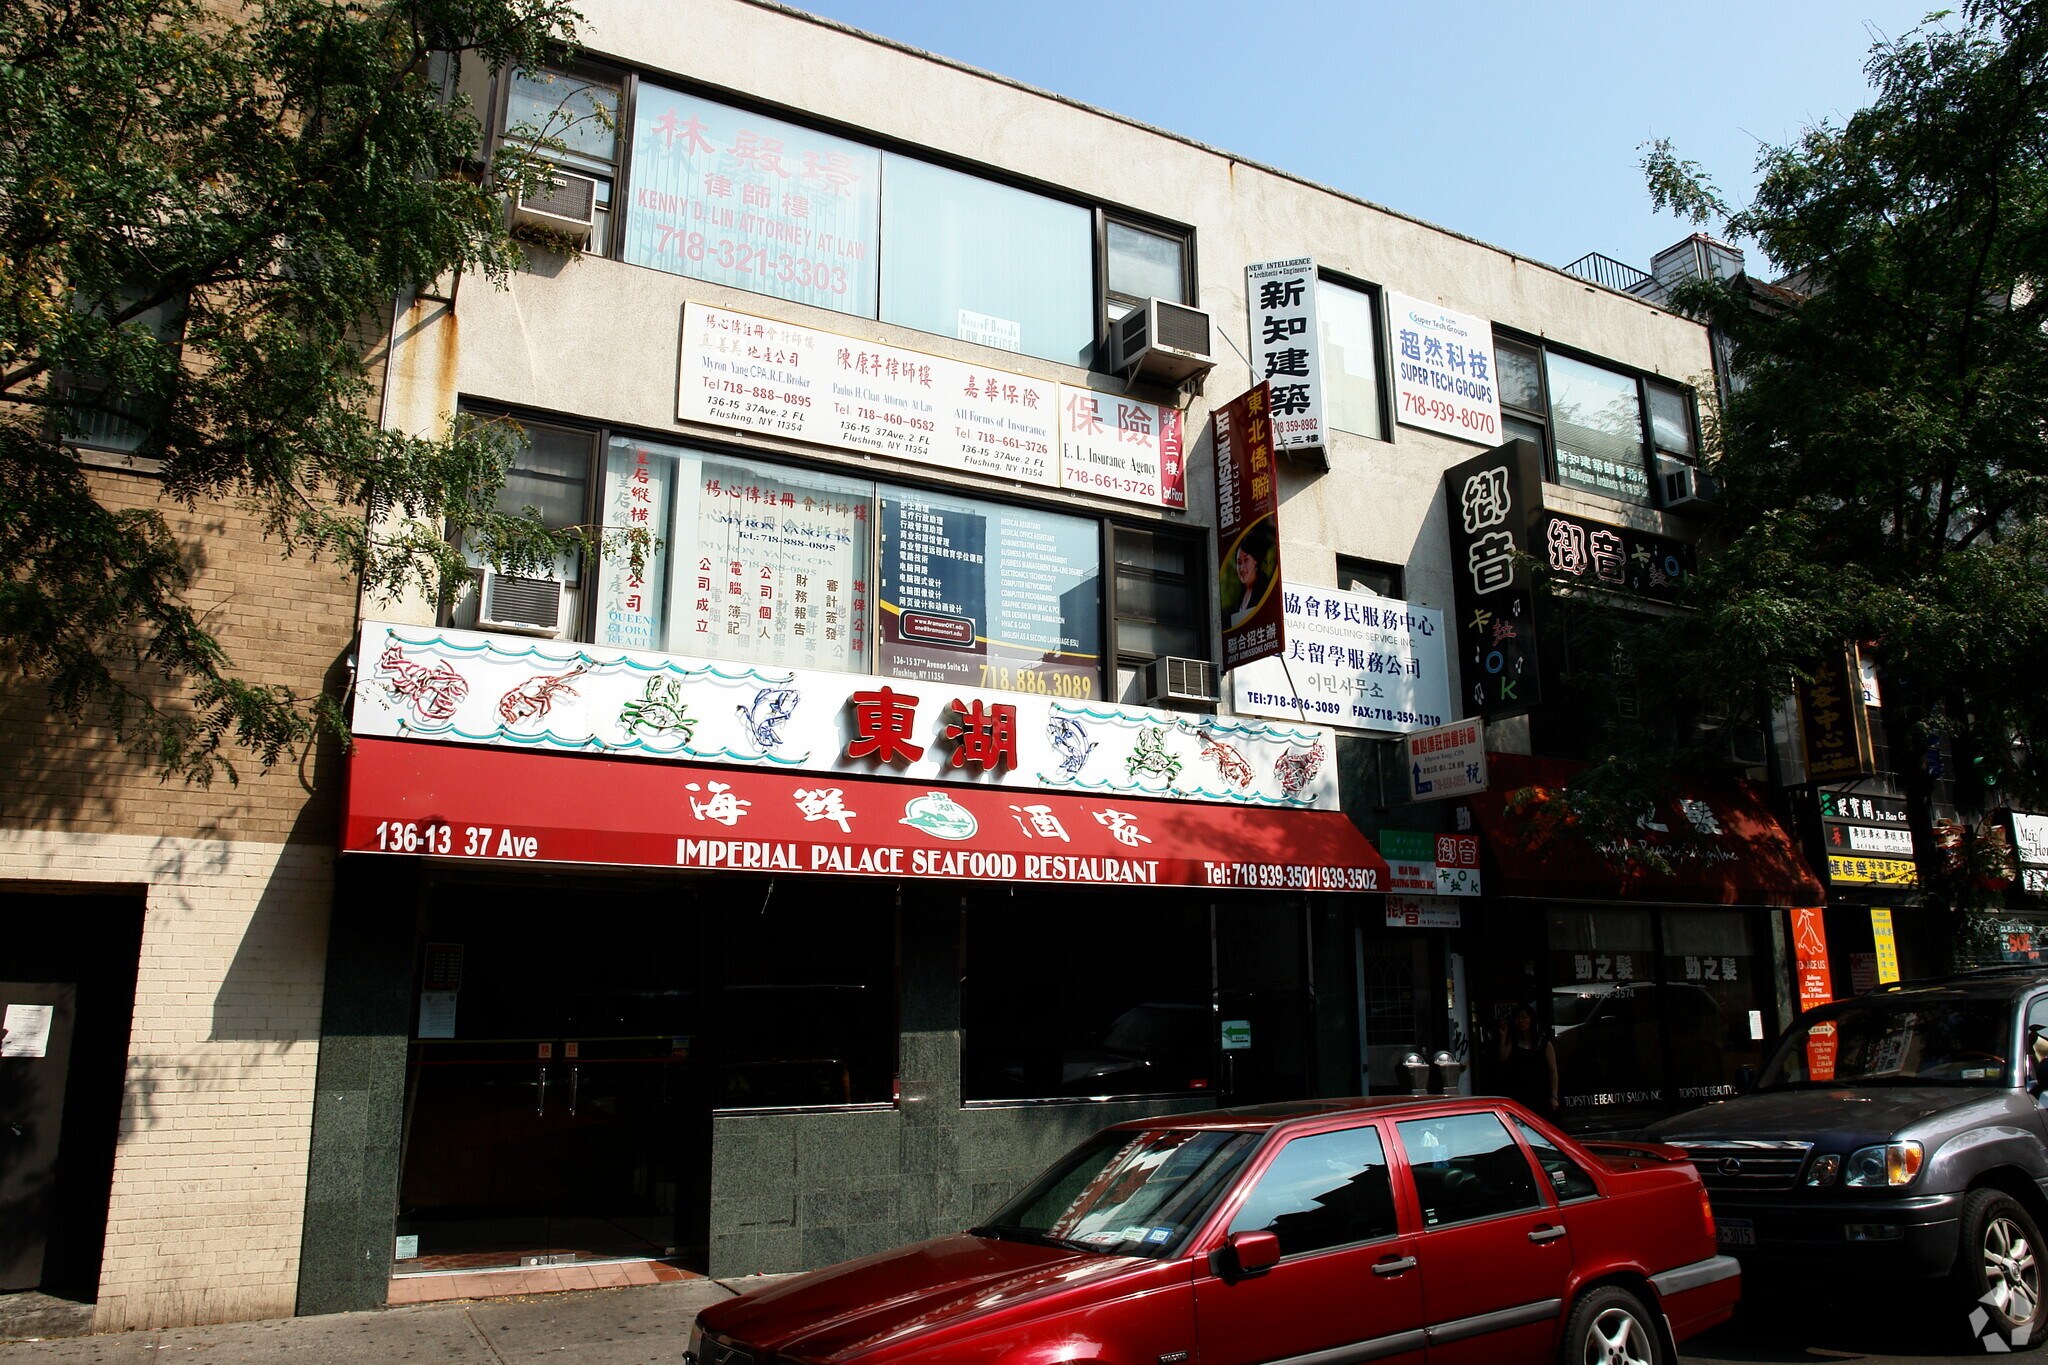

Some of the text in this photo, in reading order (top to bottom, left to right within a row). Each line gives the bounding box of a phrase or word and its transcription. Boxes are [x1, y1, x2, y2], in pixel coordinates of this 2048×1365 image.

[704, 172, 810, 219] 律師樓
[638, 187, 688, 217] KENNY
[711, 205, 734, 228] LIN
[739, 215, 812, 247] ATTORNEY
[817, 234, 834, 254] AT
[838, 237, 866, 261] LAW
[656, 223, 848, 295] 718-321-3303
[1249, 257, 1312, 272] NEW INTELLIGENCE
[1253, 266, 1308, 279] Architects Engineers
[1414, 314, 1468, 337] Super Tech Groups
[1260, 278, 1312, 418] 新知建築
[1400, 328, 1489, 381] 超然科技
[702, 356, 727, 373] Myron
[731, 361, 749, 379] Yang
[837, 347, 933, 389] 陳康年律師樓
[723, 380, 811, 408] 718-888-0895
[832, 382, 854, 397] Paulus
[883, 394, 908, 411] Attorney
[920, 400, 933, 413] Law
[964, 374, 1040, 410] 嘉華保險
[1400, 362, 1492, 404] SUPER TECH GROUPS
[707, 395, 740, 409] 136-15
[792, 411, 805, 422] FL
[709, 407, 803, 433] Flushing, NY 11354
[857, 407, 935, 433] 718-460-0582
[954, 408, 1047, 437] All Forms of Insurance
[1066, 392, 1153, 449] 保險
[1402, 391, 1494, 434] 718-939-8070
[840, 421, 870, 434] 136-15
[919, 435, 931, 445] FL
[1285, 417, 1318, 433] 359-8982
[842, 432, 929, 455] Flushing, NY 11354
[961, 444, 989, 456] 136-15
[1034, 458, 1045, 468] FL
[977, 431, 1048, 454] 718-661-3726
[1163, 412, 1179, 476] 請上二樓
[1247, 391, 1270, 501] 東北僑聯
[964, 455, 1044, 478] Flushing, NY 11354
[1063, 443, 1156, 478] E. L. Insurance Agency
[1066, 467, 1155, 496] 718-661-3726
[1172, 487, 1184, 501] Floor
[1217, 437, 1235, 530] BRAMSON
[1232, 462, 1241, 523] COLLEGE
[720, 516, 852, 543] MYRON YANG CPA
[695, 557, 712, 634] 公司成立
[727, 561, 743, 635] 電腦簿記
[758, 566, 773, 640] 公司個人
[793, 573, 809, 637] 財務報告
[608, 611, 657, 627] QUEENS
[1284, 591, 1435, 637] 協會移民服務中心
[607, 634, 658, 648] REALTY
[608, 624, 656, 639] GLOBAL
[1307, 623, 1418, 649] CONSULTING SERVICE INC.
[893, 655, 970, 672] 136-15 Avenue Suite 2A
[893, 667, 945, 681] Flushing, NY 11354
[979, 664, 1092, 700] 718.886.3089
[1308, 673, 1385, 699] 이민사무소
[847, 684, 1020, 772] 東湖
[684, 779, 857, 833] 海鮮
[1876, 810, 1885, 821] Ju
[376, 821, 540, 859] 136-13 37 Ave
[1011, 803, 1152, 848] 酒家
[676, 838, 1160, 884] IMPERIAL PALACE SEAFOOD RESTAURANT
[1259, 864, 1378, 890] 939-3501/939-3502
[1564, 1091, 1650, 1107] TOPSTYLE BEAUTY SALON
[1679, 1084, 1733, 1099] TOPSTYLE BEAUTY
